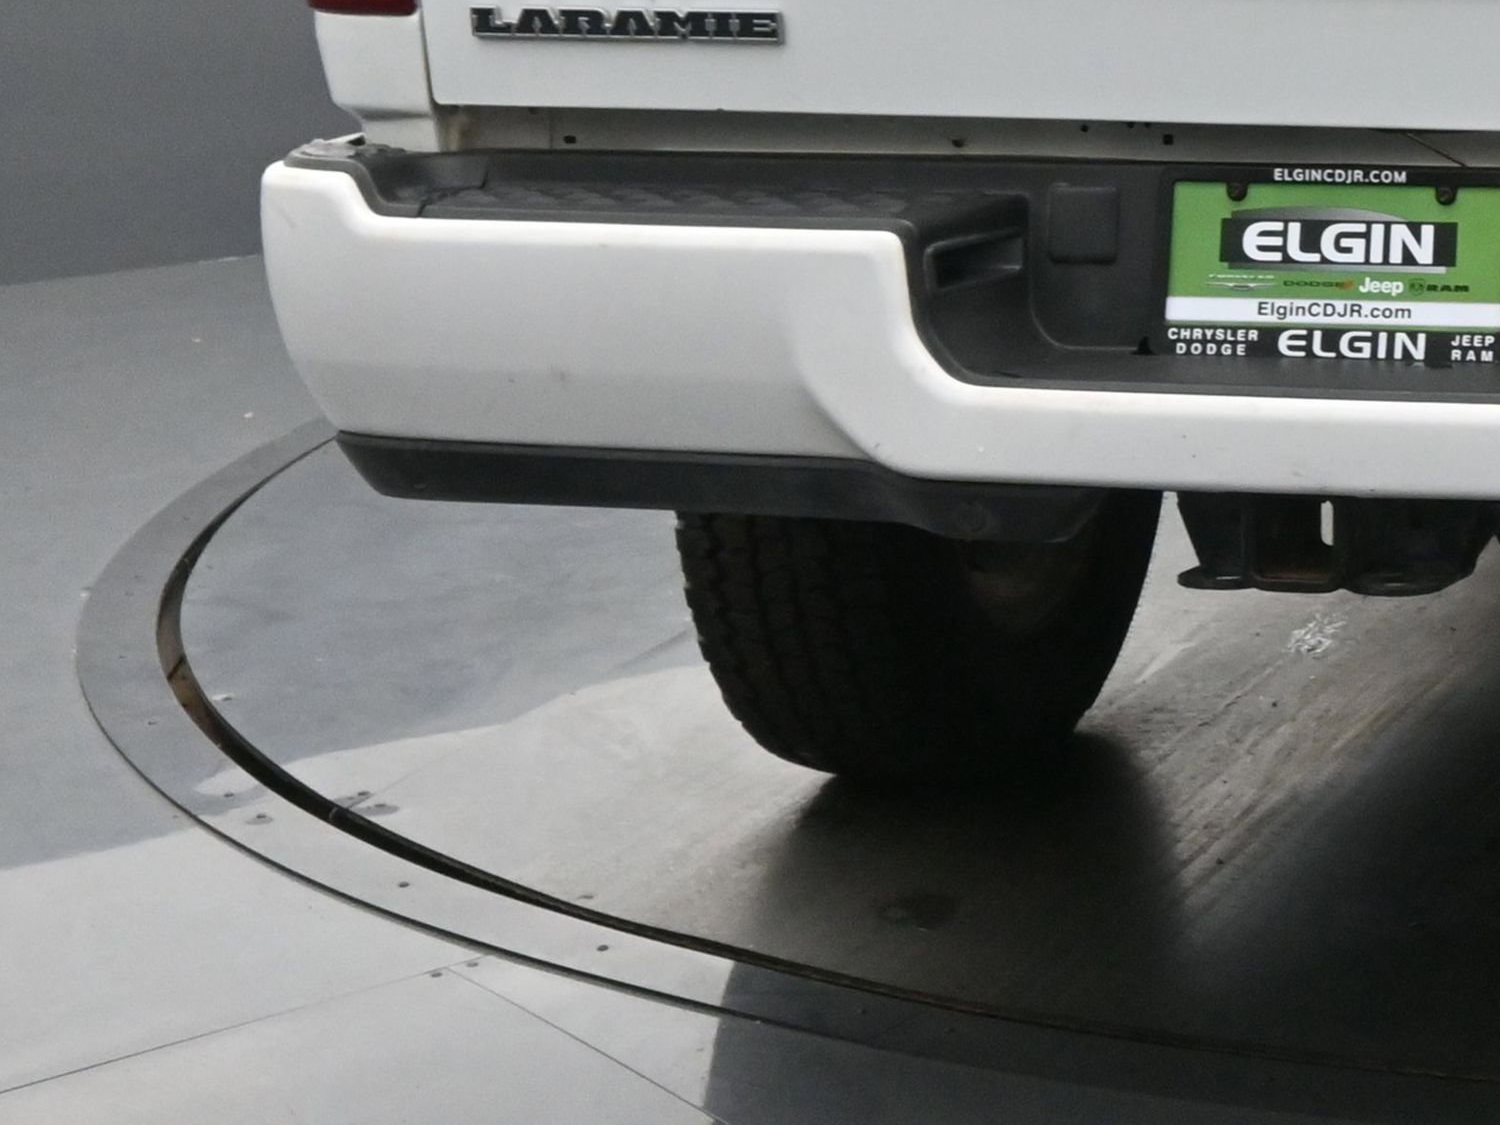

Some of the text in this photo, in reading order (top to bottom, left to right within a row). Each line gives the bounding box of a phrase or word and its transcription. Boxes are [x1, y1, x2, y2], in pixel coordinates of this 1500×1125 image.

[470, 6, 785, 46] LARAMIE
[1273, 168, 1407, 184] ELGINCDJR.COM
[1241, 221, 1436, 265] ELGIN
[1358, 277, 1404, 296] Jeep
[1427, 283, 1470, 293] RAM
[1257, 301, 1412, 320] ElginCDJR.com
[1168, 328, 1259, 342] CHRYSLER
[1451, 334, 1496, 347] JEEP
[1176, 343, 1246, 356] DODGE
[1277, 329, 1427, 361] ELGIN
[1451, 349, 1495, 362] RAM
